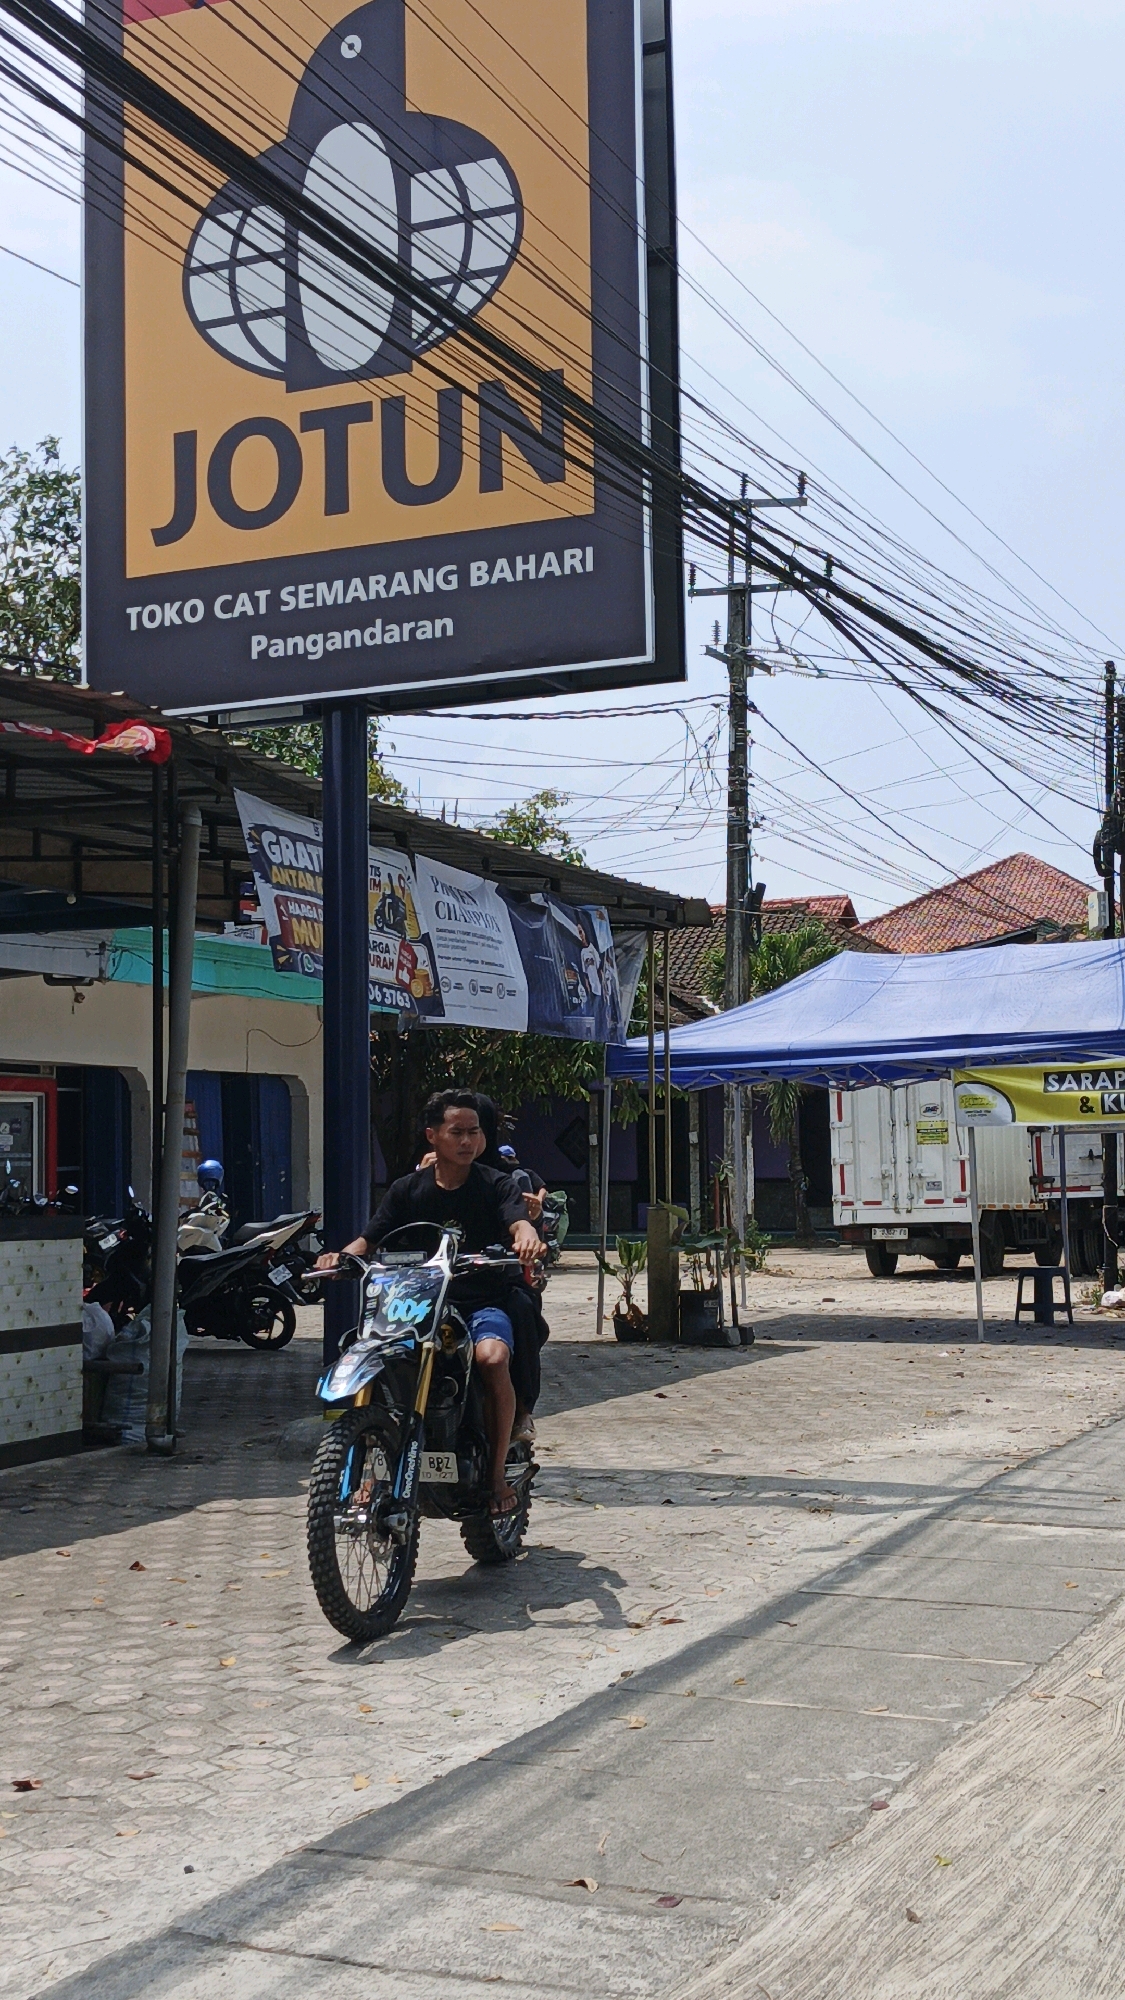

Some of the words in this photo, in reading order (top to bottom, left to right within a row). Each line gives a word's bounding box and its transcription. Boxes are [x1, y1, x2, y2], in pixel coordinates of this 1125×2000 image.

[151, 369, 565, 547] JOTUN
[126, 598, 205, 632] TOKO
[213, 588, 271, 620] CAT
[279, 564, 458, 611] SEMARANG
[469, 546, 594, 588] BAHARI
[250, 616, 455, 660] Pangandaran
[271, 865, 313, 892] ANTAR
[1046, 1070, 1125, 1092] SARAP
[1079, 1095, 1096, 1114] &
[428, 1456, 452, 1470] BPZ
